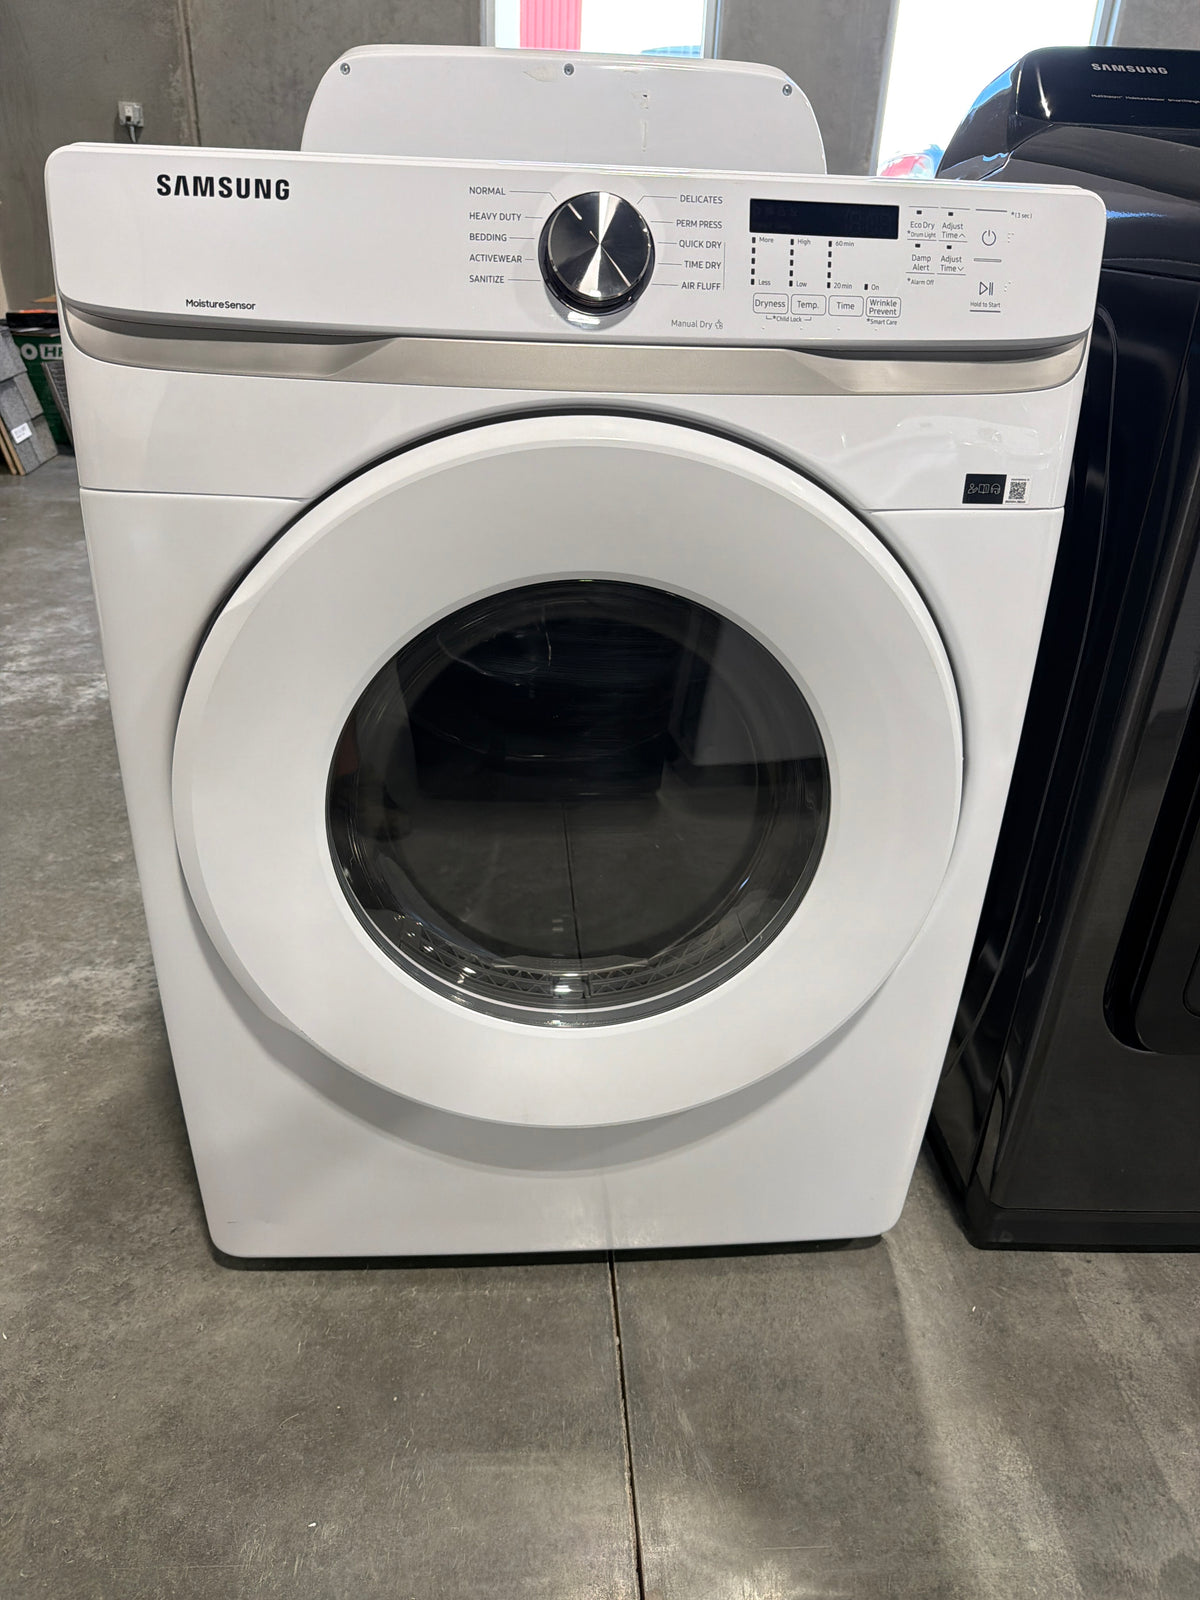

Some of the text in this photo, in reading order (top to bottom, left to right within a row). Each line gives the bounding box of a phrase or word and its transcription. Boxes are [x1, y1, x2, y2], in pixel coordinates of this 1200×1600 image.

[1091, 63, 1168, 74] SAMSUNG
[157, 174, 290, 200] SAMSUNG
[469, 186, 506, 195] NORMAL
[680, 195, 723, 204] DELICATES
[469, 212, 522, 221] HEAVY DUTY
[676, 219, 722, 229] PERM PRESS
[942, 222, 963, 230] Adjust
[469, 233, 507, 242] BEDDING
[679, 239, 721, 249] QUICK DRY
[469, 253, 522, 263] ACTIVEWEAR
[912, 254, 931, 262] Damp
[941, 256, 962, 264] Adjust
[684, 260, 721, 270] TIME DRY
[913, 263, 930, 271] Alert
[941, 264, 956, 272] Time
[469, 274, 505, 283] SANITIZE
[681, 281, 721, 290] AIR FLUFF
[186, 299, 256, 310] MoistureSensor
[755, 299, 786, 309] Dryness
[797, 300, 819, 309] Temp.
[837, 302, 855, 310] Time
[869, 299, 897, 307] Wrinkle
[869, 307, 897, 316] Prevent
[671, 319, 713, 329] Manual Dry
